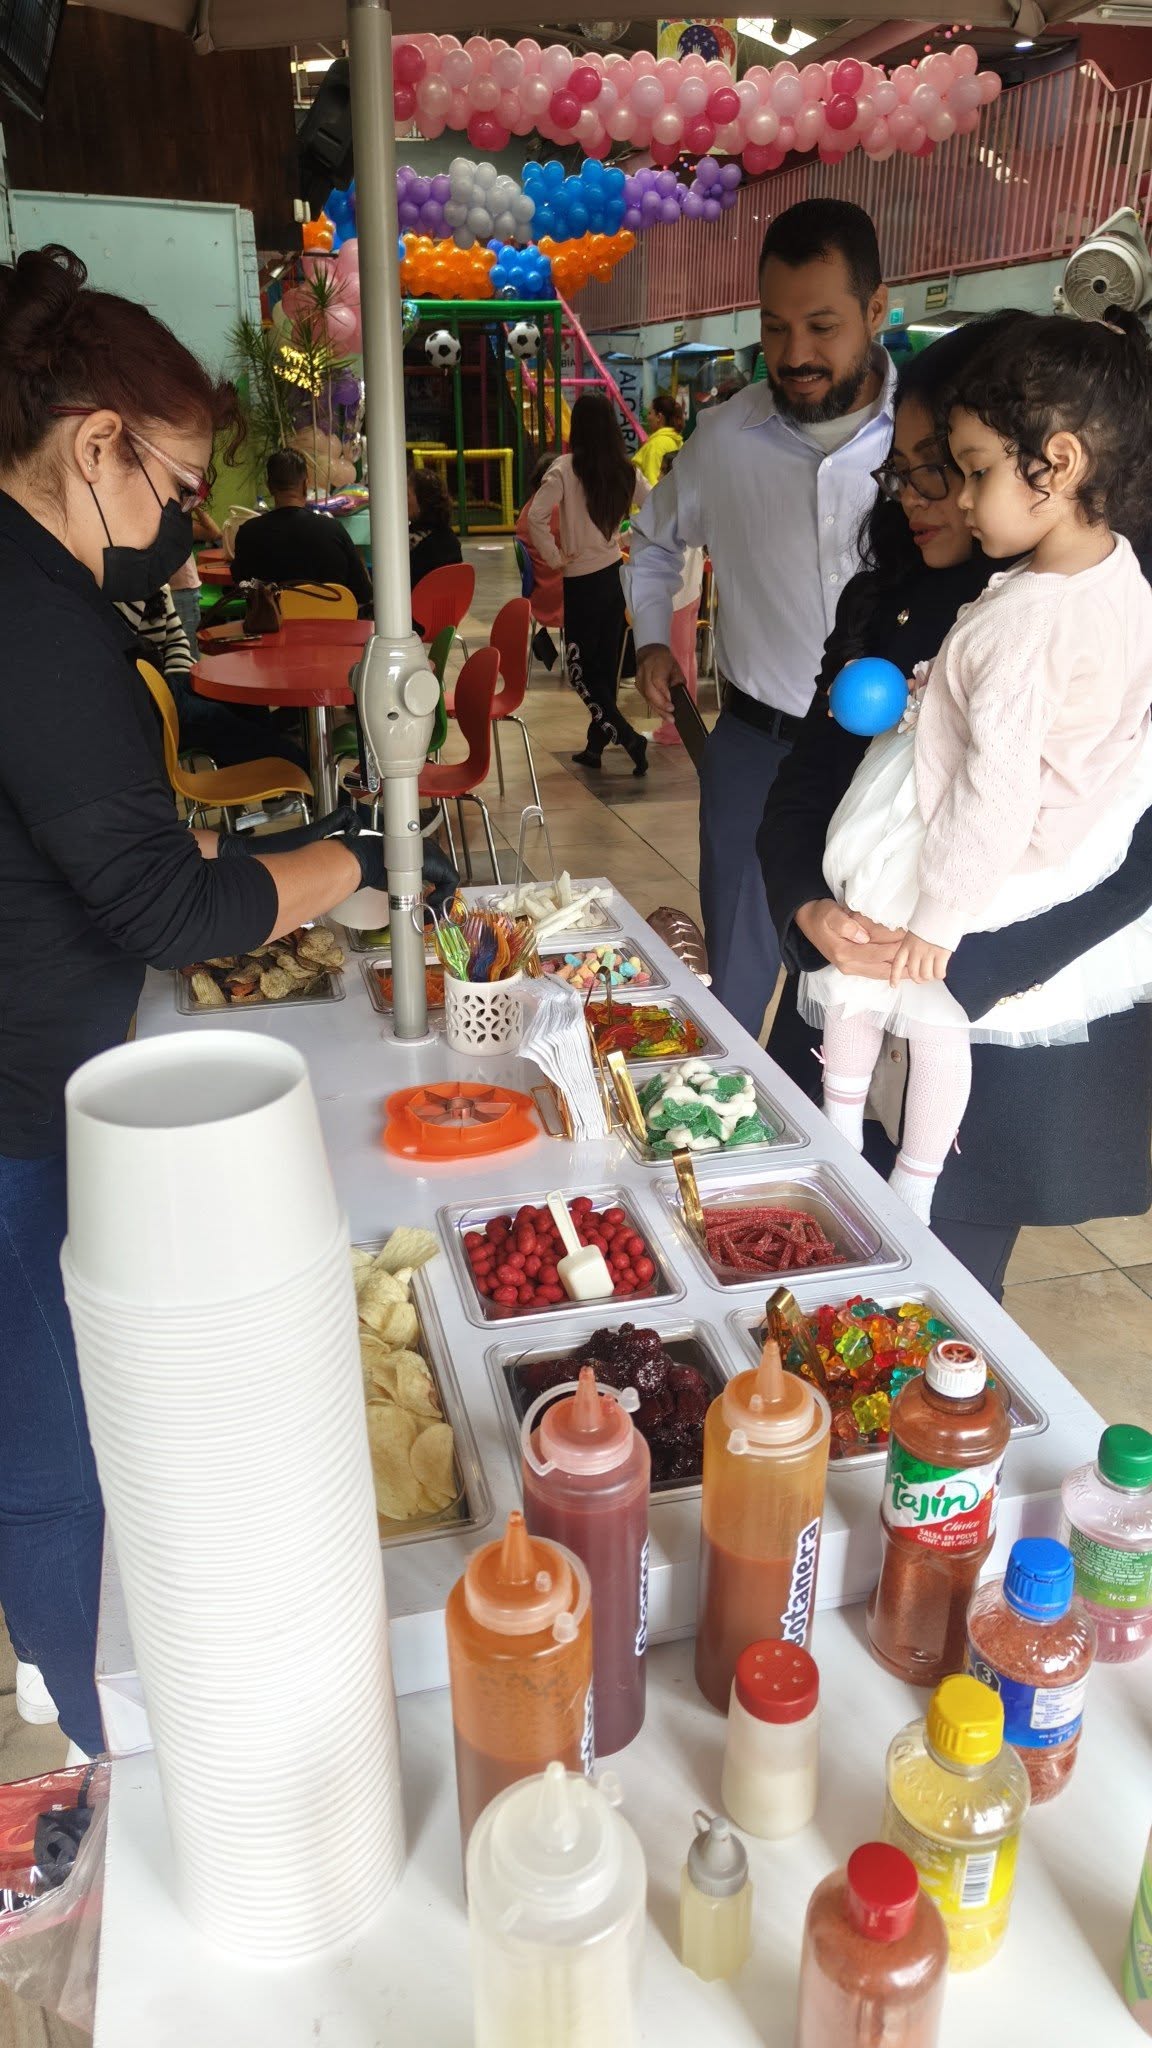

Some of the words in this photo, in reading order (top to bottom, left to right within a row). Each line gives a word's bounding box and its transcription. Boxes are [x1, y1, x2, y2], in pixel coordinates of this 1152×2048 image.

[917, 1534, 940, 1546] CONT.
[919, 1528, 942, 1541] SALSA
[955, 1531, 978, 1541] POLVO
[982, 1666, 992, 1684] 3
